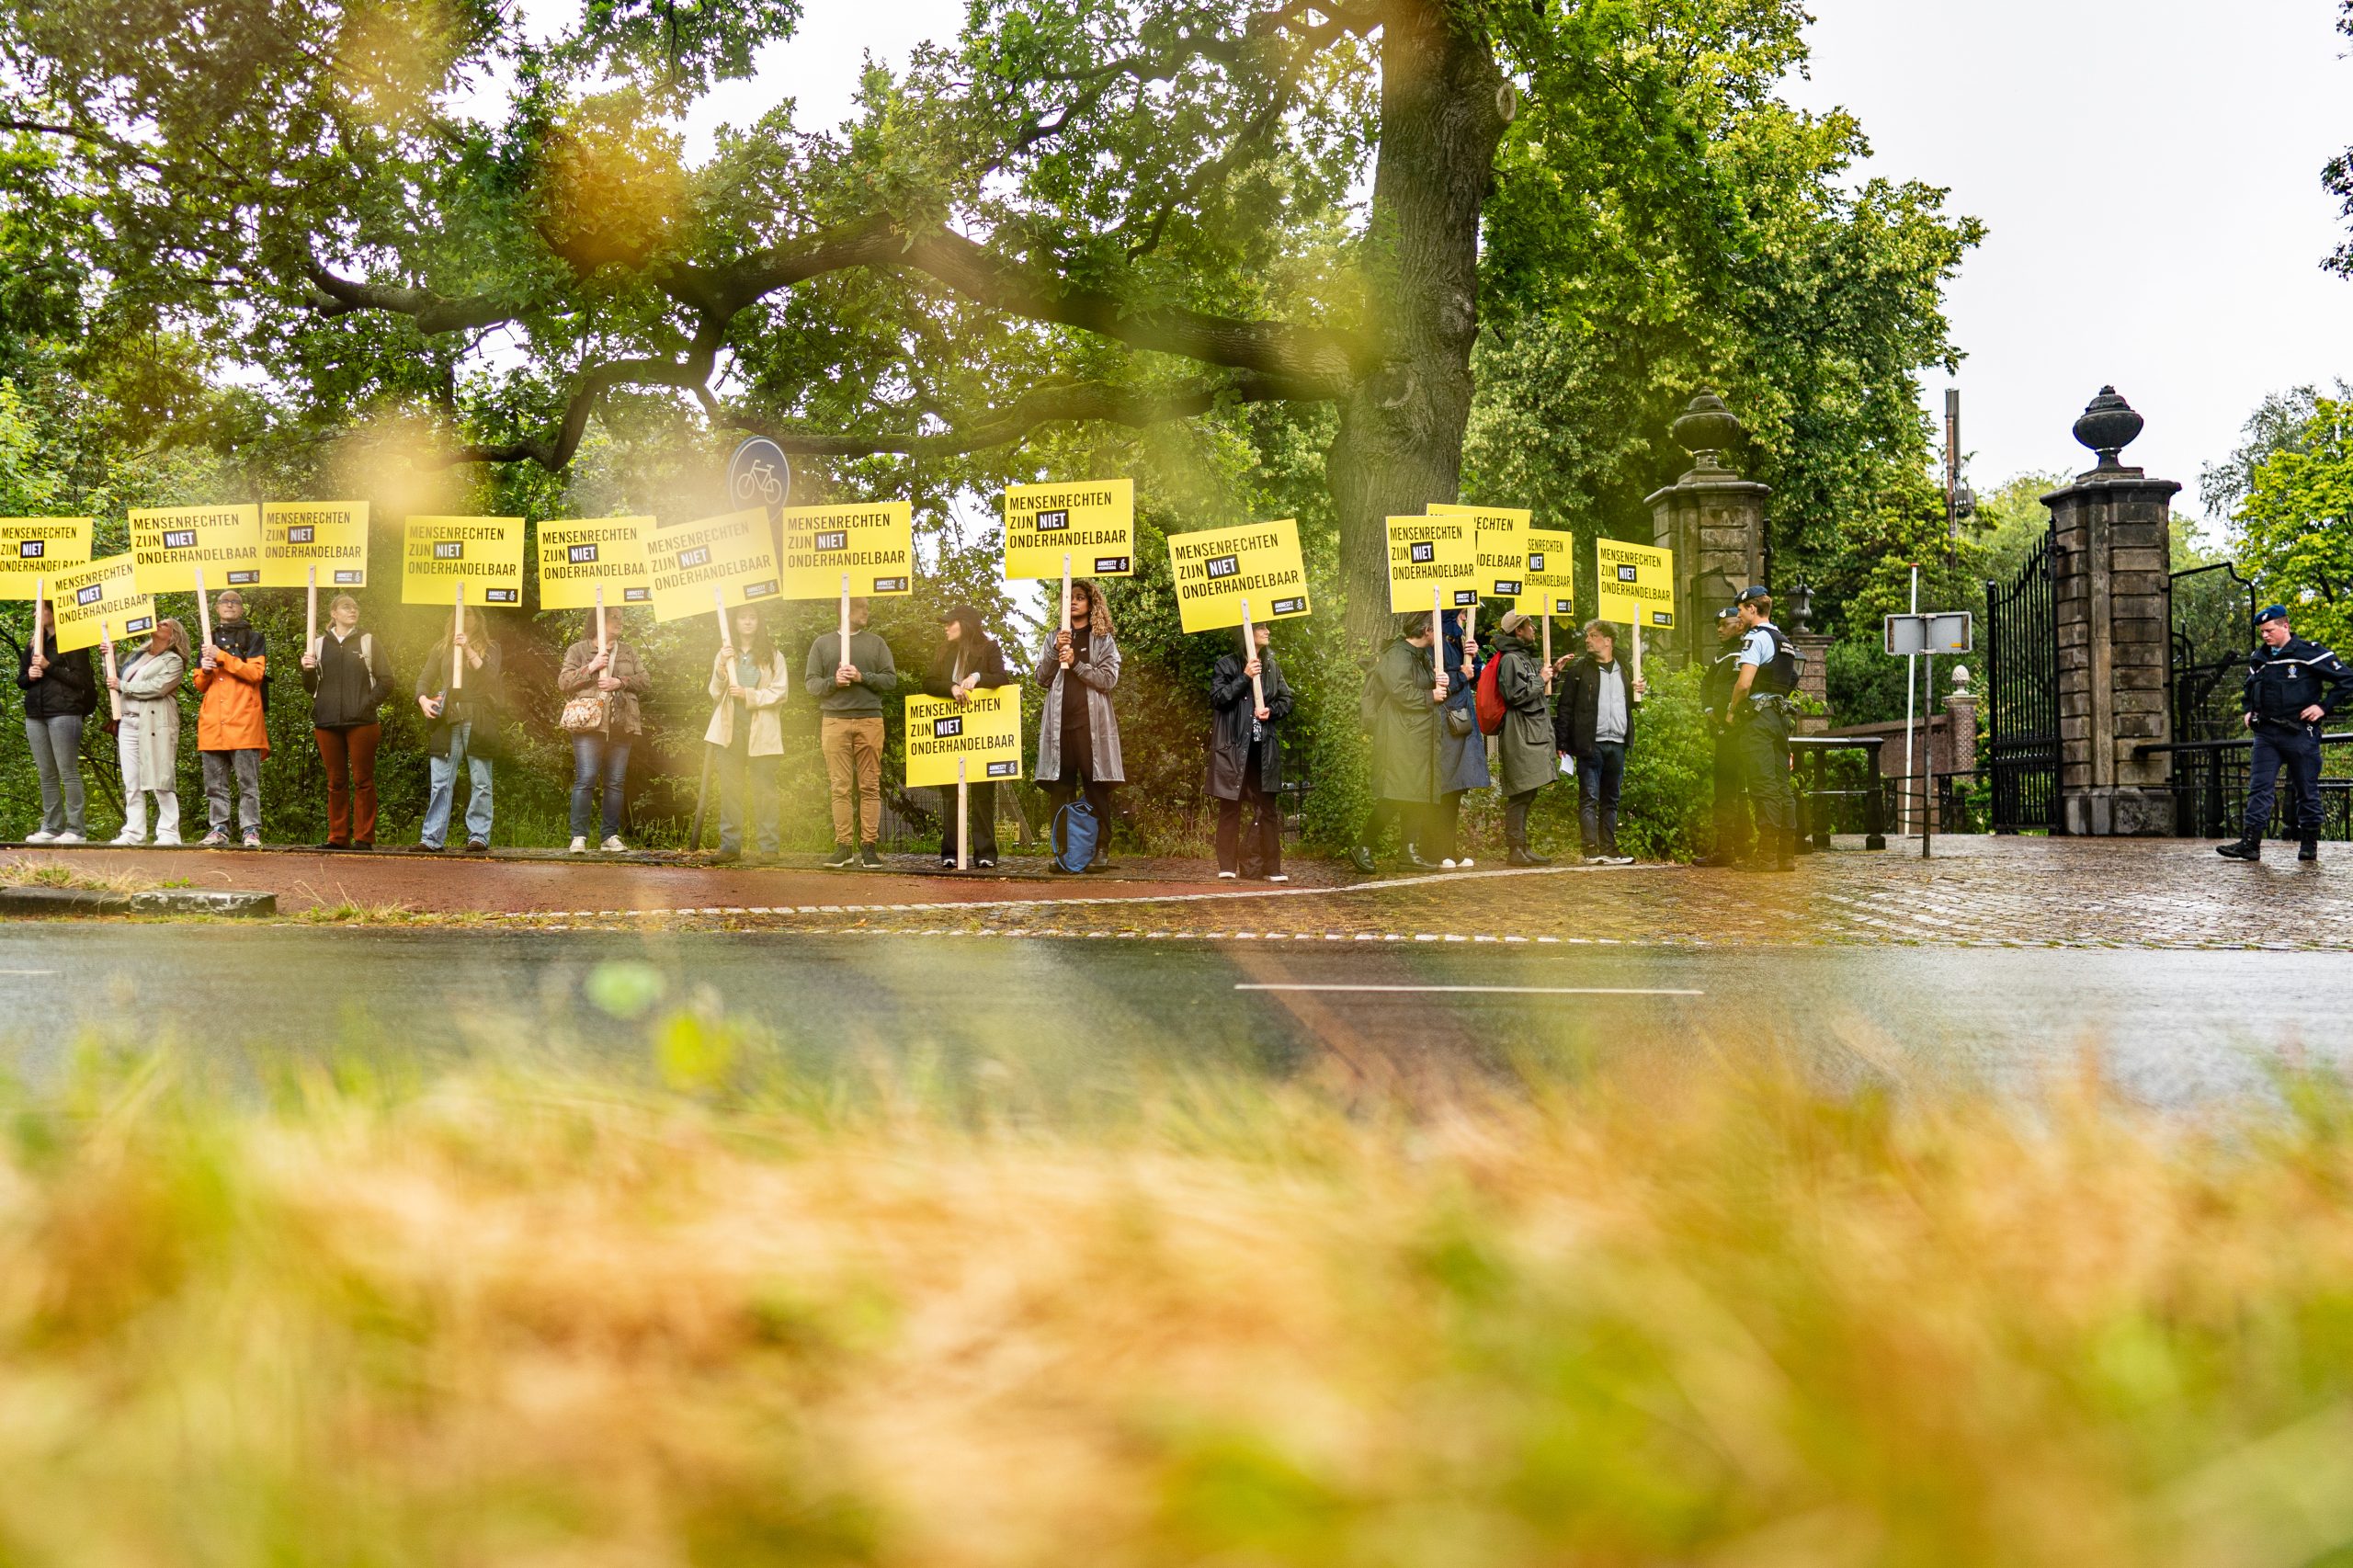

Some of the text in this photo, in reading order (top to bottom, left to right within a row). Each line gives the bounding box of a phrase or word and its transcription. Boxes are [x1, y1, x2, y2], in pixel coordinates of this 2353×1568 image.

[1010, 492, 1111, 510] MENSENRECHTEN
[133, 514, 239, 530] MENSENRECHTEN
[267, 512, 351, 524] MENSENRECHTEN
[788, 514, 890, 530] MENSENRECHTEN
[1010, 513, 1065, 529] ZIJN NIET
[1, 527, 77, 539] MENSENRECHTEN
[136, 532, 194, 547] ZIJN NIET
[266, 528, 313, 541] ZIJN NIET
[409, 526, 505, 540] MENSENRECHTEN
[542, 528, 637, 544] MENSENRECHTEN
[647, 521, 749, 555] MENSENRECHTEN
[1010, 530, 1126, 549] ONDERHANDELBAAR
[1390, 526, 1462, 540] MENSENRECHTEN
[1, 542, 43, 556] ZIJN NIET
[788, 534, 844, 549] ZIJN NIET
[1175, 533, 1279, 560] MENSENRECHTEN
[1528, 538, 1563, 552] SENRECHTEN
[137, 547, 257, 564] ONDERHANDELBAAR
[265, 546, 361, 558] ONDERHANDELBAAR
[408, 544, 461, 557] ZIJN NIET
[543, 547, 596, 562] ZIJN NIET
[1392, 545, 1431, 561] ZIJN NIET
[1600, 547, 1662, 568] MENSENRECHTEN
[652, 549, 707, 573] ZIJN NIET
[788, 551, 905, 567] ONDERHANDELBAAR
[1529, 556, 1543, 569] NIET
[408, 562, 517, 576] ONDERHANDELBAAR
[544, 562, 647, 580] ONDERHANDELBAA
[654, 554, 771, 591] ONDERHANDELBAAR
[1179, 559, 1235, 580] ZIJN NIET
[1392, 563, 1474, 580] ONDERHANDELBAAR
[1601, 564, 1635, 581] ZIJN NIET
[55, 563, 133, 592] MENSENRECHTEN
[1182, 570, 1299, 599] ONDERHANDELBAAR
[1525, 574, 1571, 587] DERHANDELBAAR
[57, 587, 100, 608] ZIJN NIET
[1601, 581, 1671, 602] ONDERHANDELBAAR
[59, 593, 148, 624] ONDERHANDELBAAR
[910, 698, 1000, 718] MENSENRECHTEN
[911, 720, 960, 736] ZIJN NIET
[911, 734, 1015, 755] ONDERHANDELBAAR
